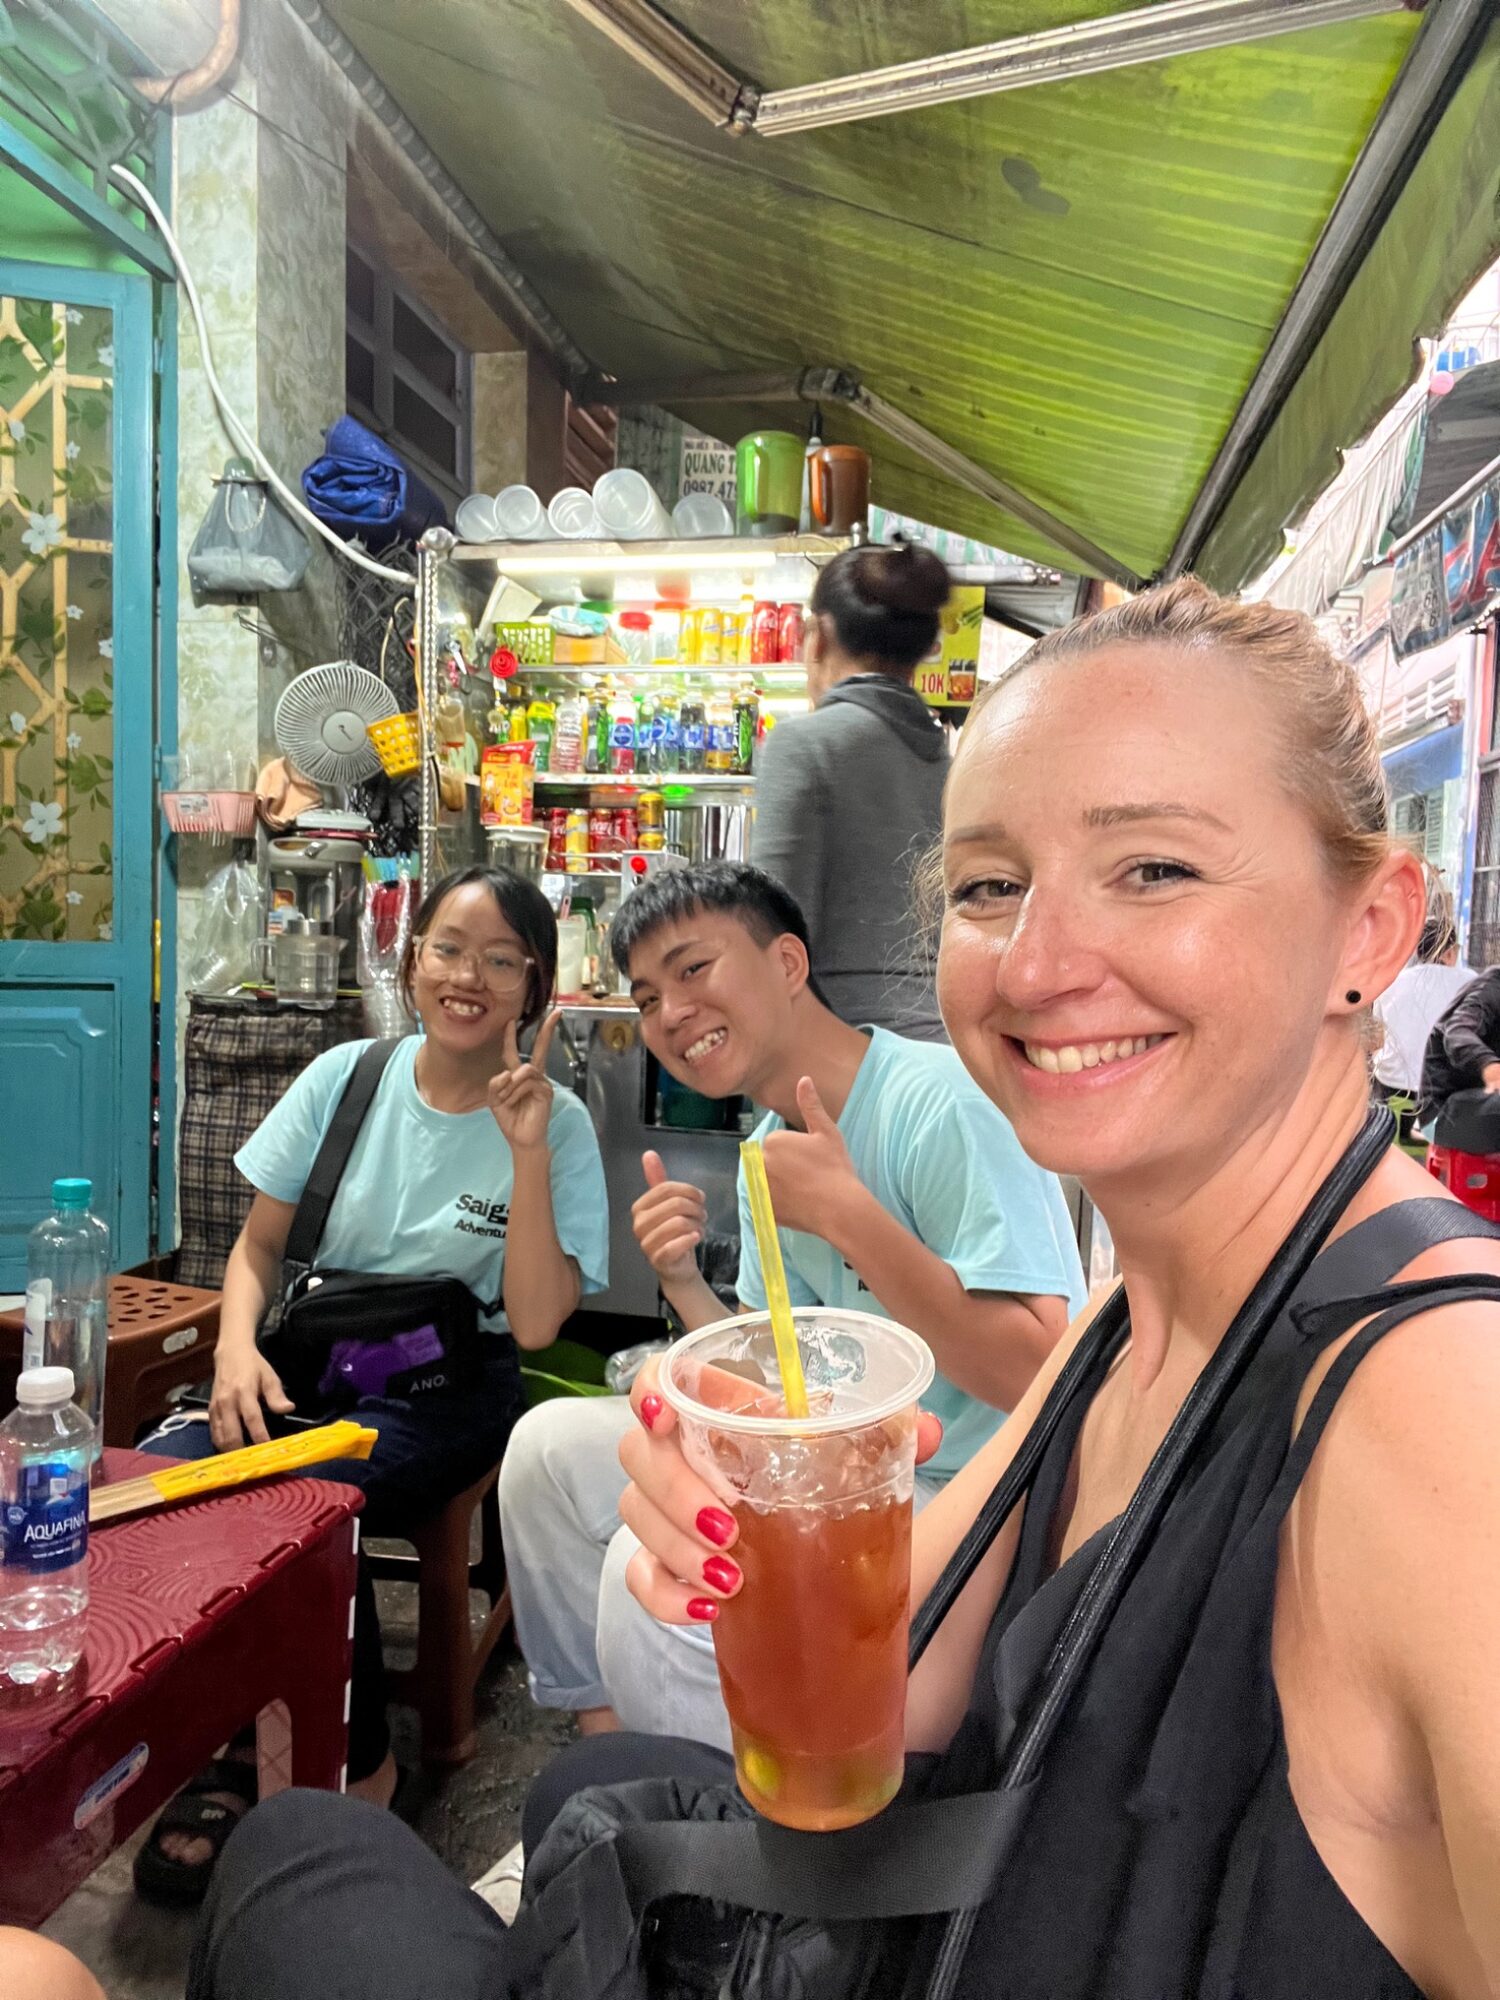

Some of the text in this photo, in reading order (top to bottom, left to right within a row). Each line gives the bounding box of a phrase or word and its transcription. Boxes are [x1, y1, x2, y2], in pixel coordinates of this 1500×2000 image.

[685, 453, 725, 477] QUANG
[921, 673, 944, 693] 10K
[456, 1194, 510, 1225] Saig
